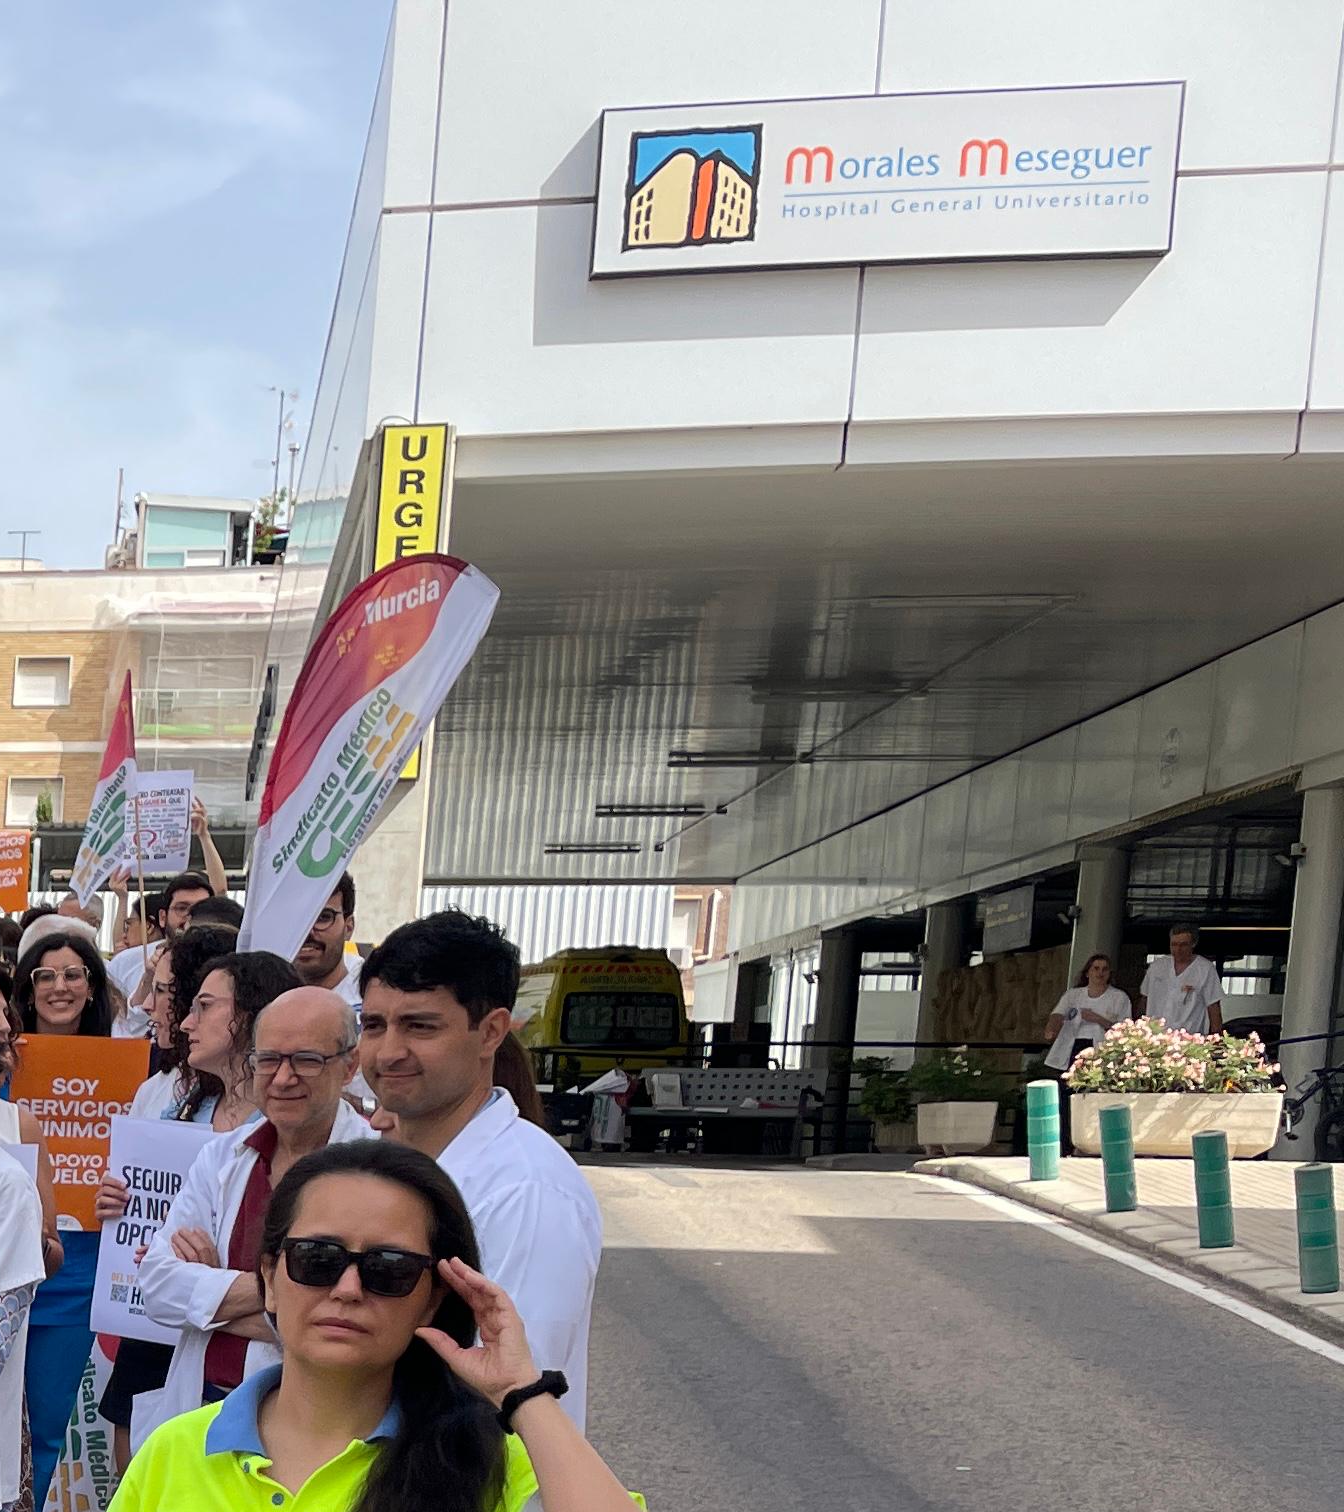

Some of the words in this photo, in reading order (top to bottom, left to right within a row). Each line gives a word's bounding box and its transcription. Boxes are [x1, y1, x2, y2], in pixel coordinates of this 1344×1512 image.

[781, 200, 878, 220] Hospital
[891, 196, 982, 214] General
[994, 191, 1150, 212] Universitario
[272, 772, 340, 874] Sindicato
[336, 687, 392, 771] Médico
[52, 1077, 99, 1096] SOY
[122, 1165, 182, 1195] SEGUIR
